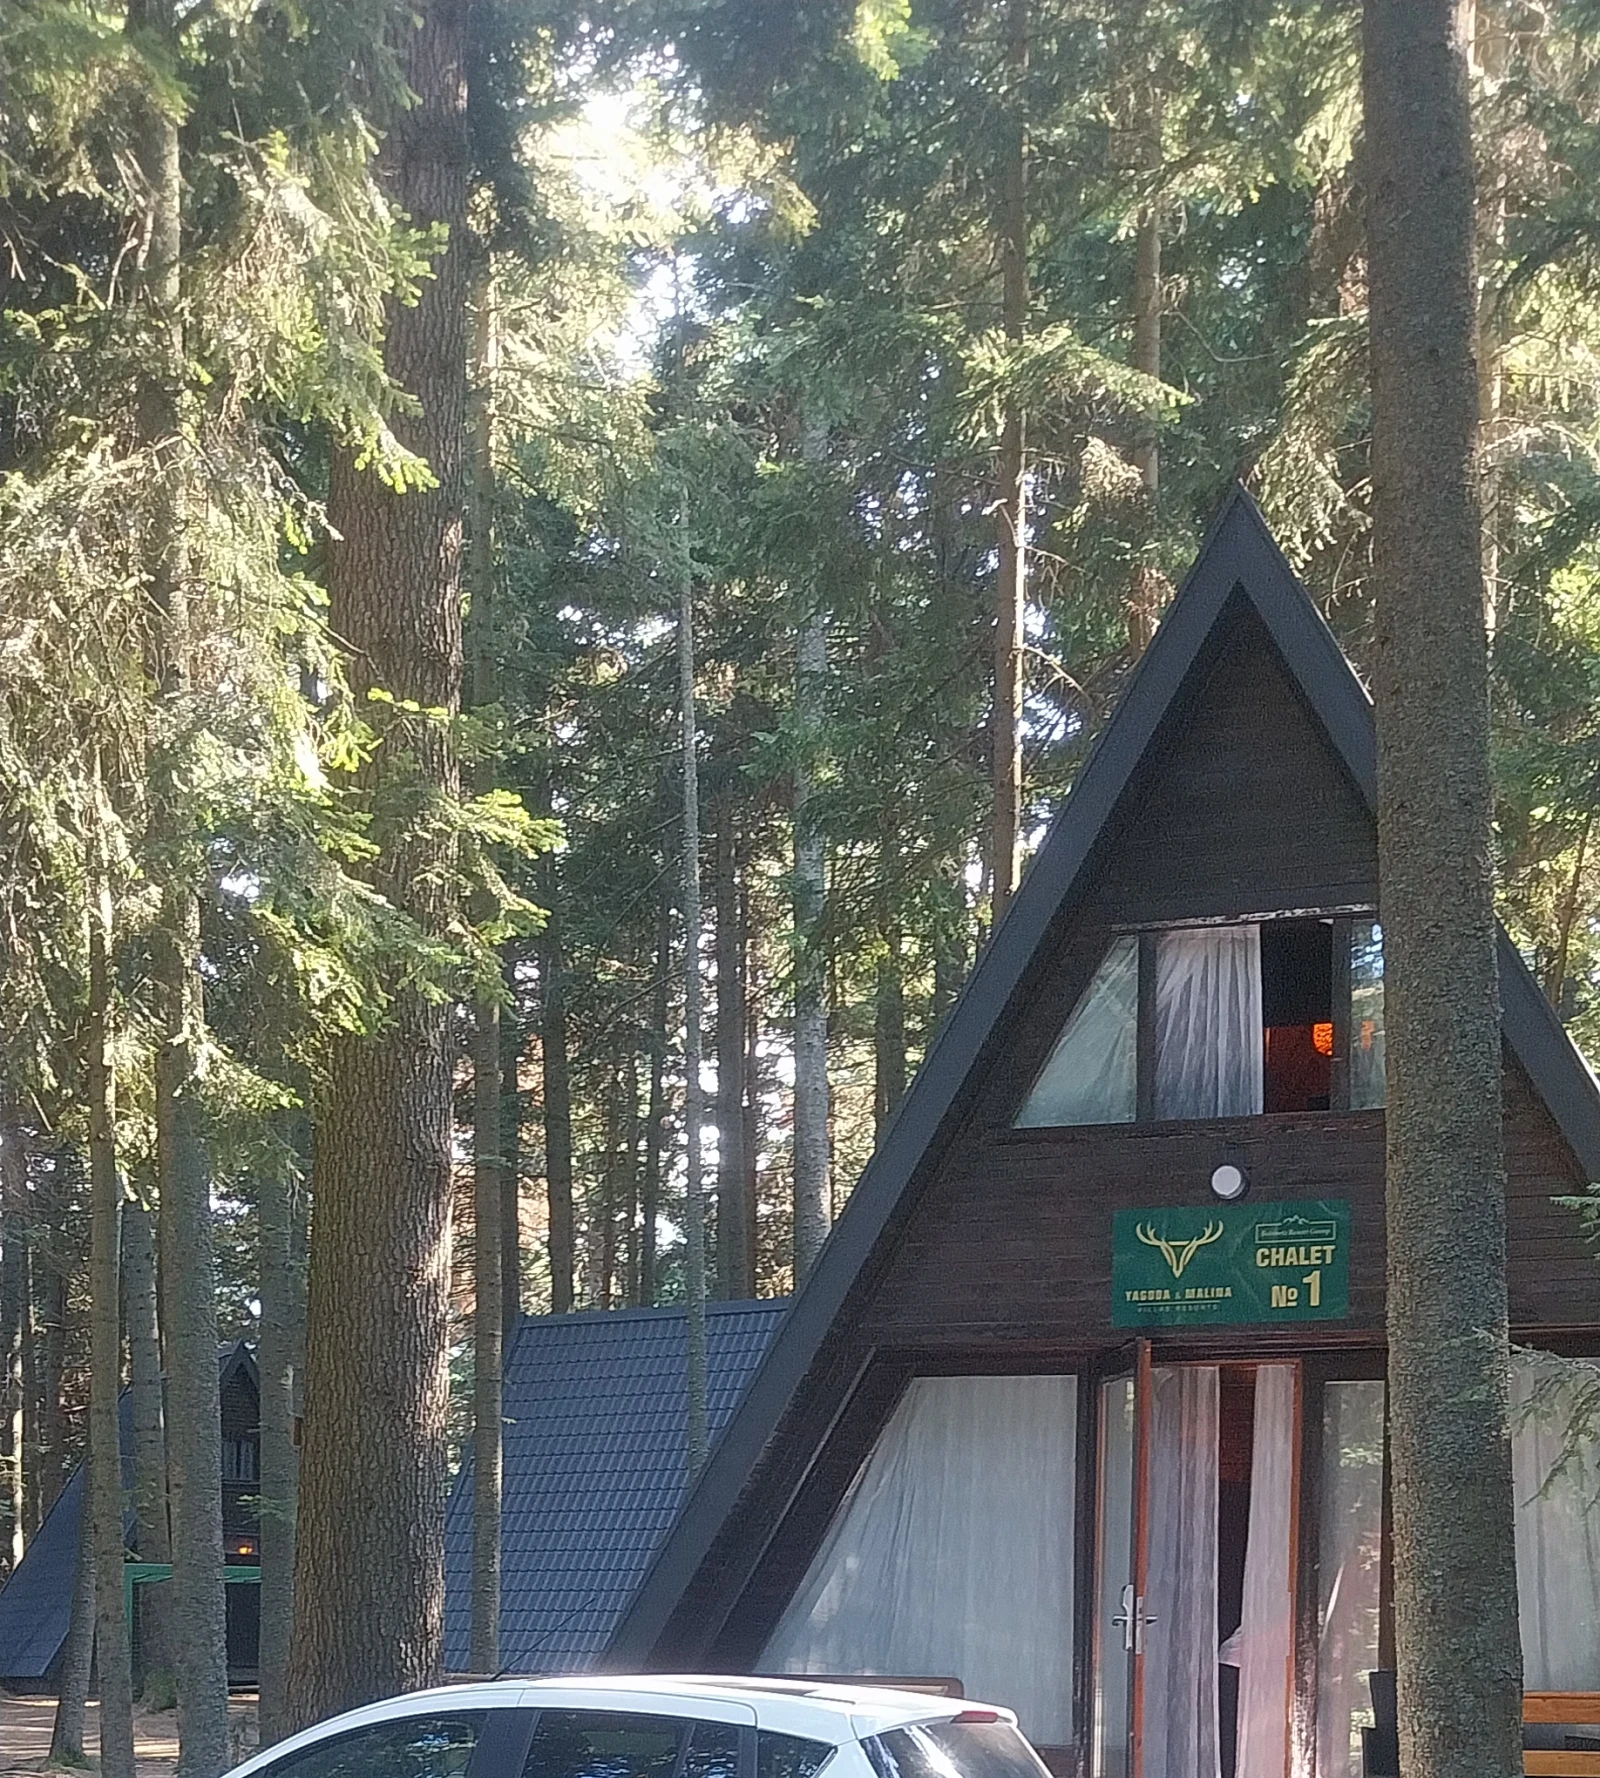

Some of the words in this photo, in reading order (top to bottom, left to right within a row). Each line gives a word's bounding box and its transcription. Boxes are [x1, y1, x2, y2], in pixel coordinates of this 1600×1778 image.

[1256, 1245, 1336, 1267] CHALET
[1125, 1289, 1171, 1301] YAGODA
[1185, 1287, 1232, 1299] MALINA
[1302, 1270, 1321, 1306] 1
